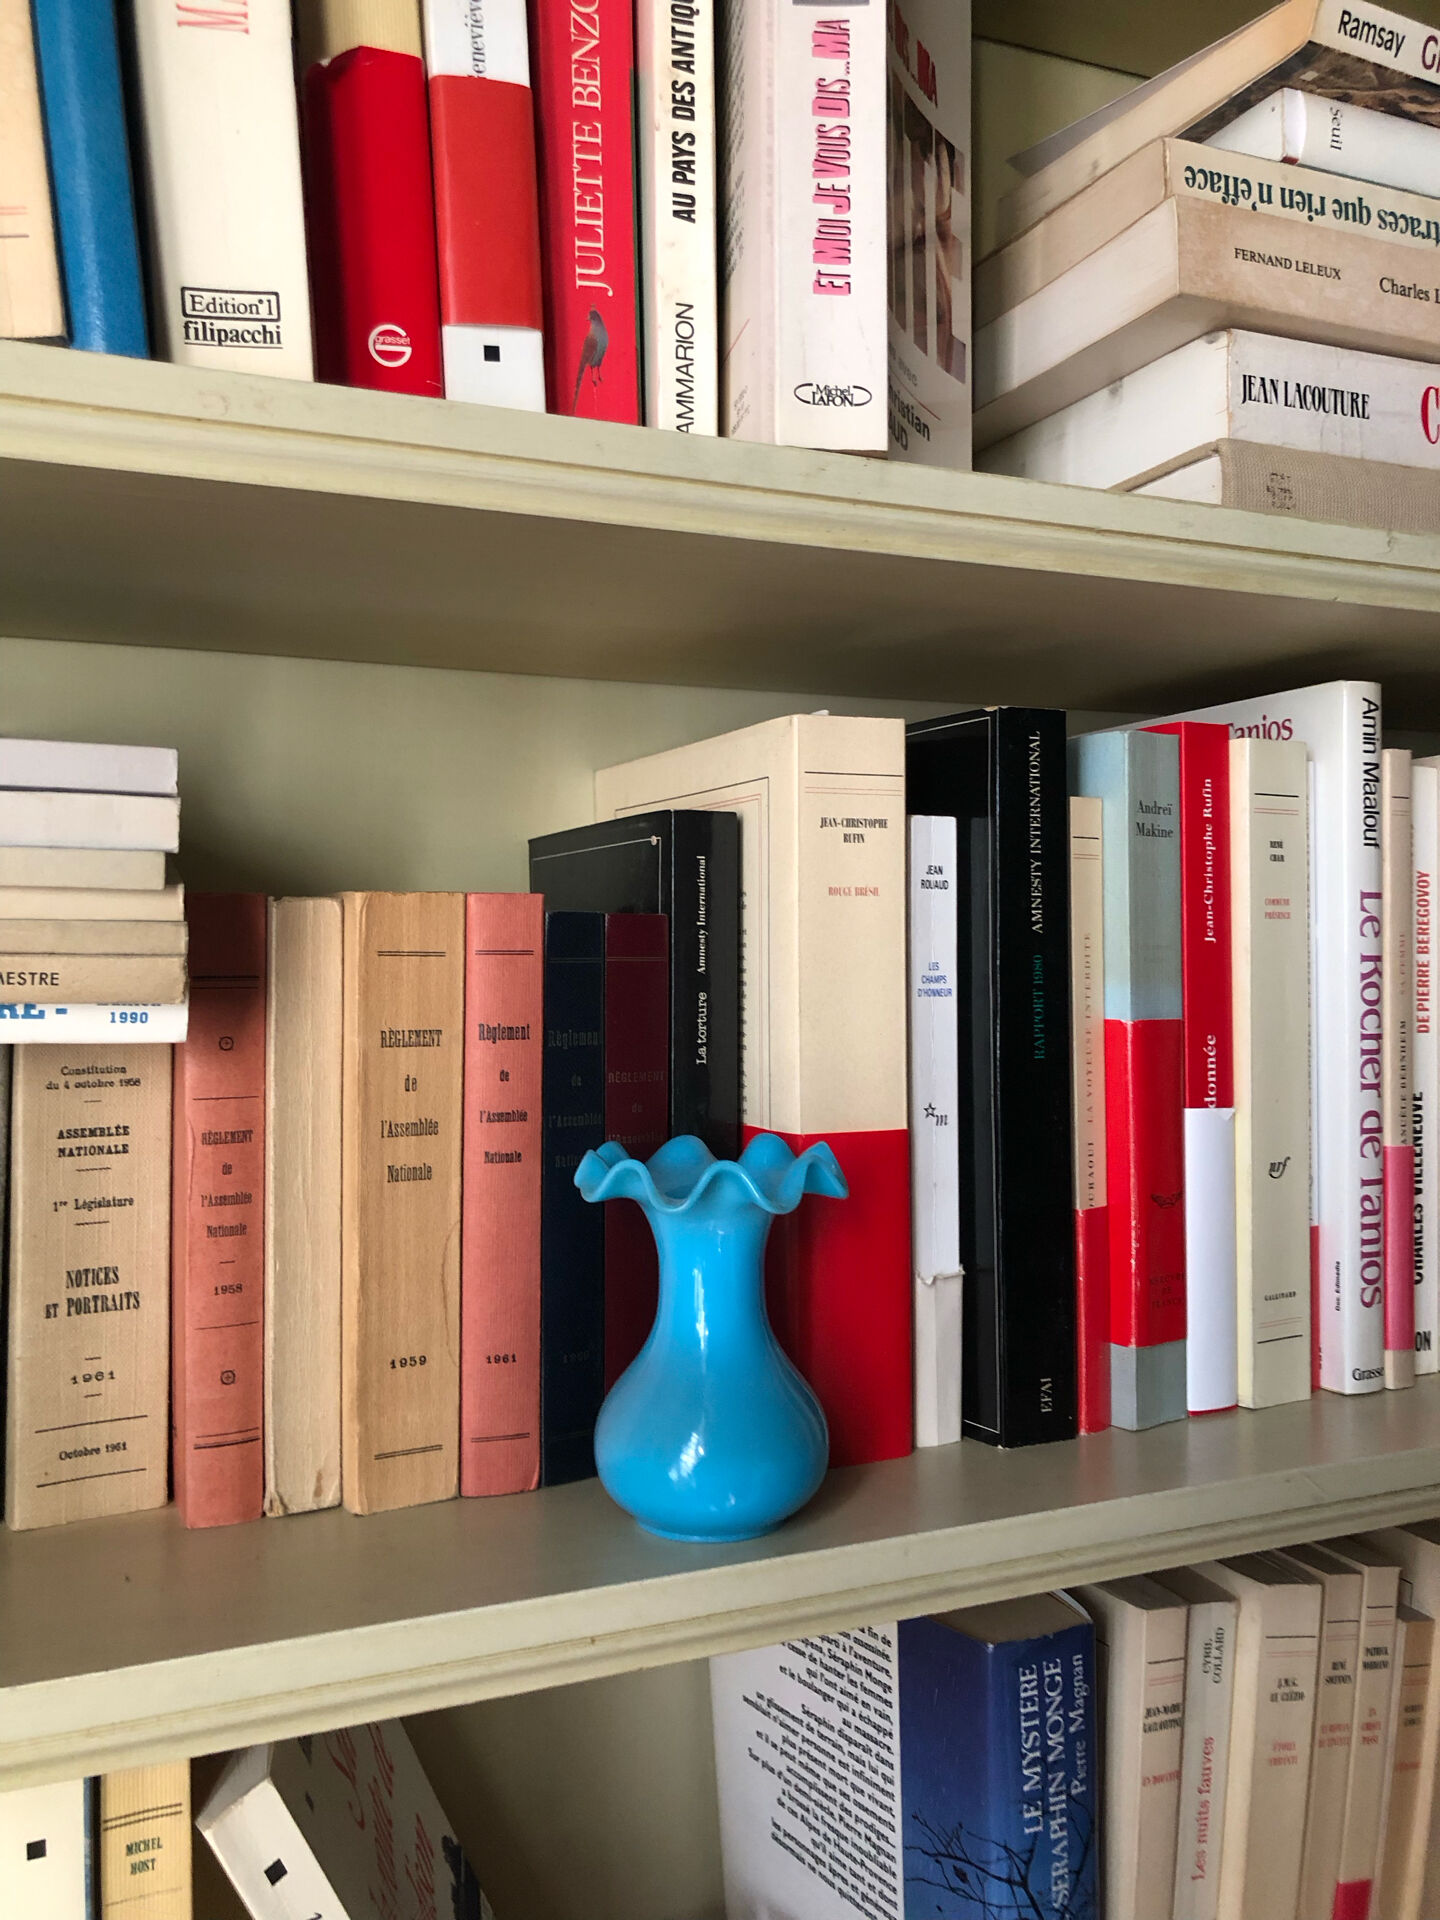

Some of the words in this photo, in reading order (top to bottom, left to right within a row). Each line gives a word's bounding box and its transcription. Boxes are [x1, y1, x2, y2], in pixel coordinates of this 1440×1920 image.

[1338, 9, 1406, 58] Ramsay
[671, 80, 696, 122] DES
[1330, 107, 1342, 151] Seuil
[672, 131, 696, 186] PAYS
[812, 124, 850, 179] VOUS
[812, 183, 850, 215] JE
[1184, 165, 1273, 211] n'efface
[573, 121, 613, 297] JULIETTE
[672, 192, 696, 224] AU
[1281, 187, 1326, 222] rien
[1332, 198, 1371, 226] que
[813, 218, 850, 265] MOI
[813, 269, 850, 295] ET
[1234, 248, 1292, 270] FERNAND
[1295, 261, 1342, 280] LELEUX
[1379, 277, 1430, 301] Charles
[184, 321, 282, 346] filipacchi
[375, 334, 411, 346] grasset
[1241, 374, 1279, 404] JEAN
[1283, 381, 1370, 419] LACOUTURE
[1362, 697, 1379, 754] Amin
[1029, 730, 1042, 852] INTERNATIONAL
[1202, 778, 1213, 818] Rufin
[1363, 761, 1379, 849] Maalouf
[820, 817, 888, 829] JEAN-CHRISTOPHE
[1136, 821, 1174, 839] Makine
[843, 833, 865, 844] RUFIN
[926, 865, 943, 876] JEAN
[1203, 824, 1216, 943] Jean-Christophe
[696, 856, 706, 926] International
[920, 879, 949, 890] ROUAUD
[1030, 859, 1043, 934] AMNESTY
[1360, 890, 1382, 938] Le
[1415, 871, 1430, 954] BEREGOVOY
[697, 928, 709, 974] Amnesty
[921, 972, 947, 984] CHAMPS
[928, 961, 940, 971] LES
[1416, 960, 1430, 1012] PIERRE
[110, 1012, 149, 1024] 1990
[697, 992, 708, 1044] torture
[1033, 988, 1046, 1060] RAPPORT
[1417, 1015, 1430, 1034] DE
[380, 1028, 442, 1048] RÈGLEMENT
[478, 1023, 530, 1043] Règlement
[696, 1046, 707, 1065] La
[61, 1064, 127, 1076] Constitution
[404, 1074, 417, 1092] de
[499, 1070, 510, 1082] de
[46, 1081, 59, 1090] du
[75, 1078, 115, 1089] octobre
[380, 1117, 439, 1138] l'Assemblée
[479, 1110, 528, 1124] l'Assemblée
[57, 1125, 130, 1139] ASSEMBLÉE
[57, 1143, 130, 1158] NATIONALE
[484, 1151, 522, 1164] Nationale
[222, 1162, 232, 1175] de
[387, 1163, 432, 1183] Nationale
[207, 1223, 247, 1238] Nationale
[66, 1266, 120, 1289] NOTICES
[214, 1284, 243, 1296] 1958
[45, 1304, 59, 1319] ET
[67, 1291, 141, 1317] PORTRAITS
[390, 1355, 427, 1369] 1959
[486, 1354, 517, 1364] 1961
[70, 1371, 116, 1385] 1961
[59, 1446, 101, 1461] Octobre
[1069, 1654, 1090, 1733] Magnan
[1043, 1658, 1065, 1762] MONGE
[1019, 1664, 1042, 1792] MYSTERE
[1198, 1736, 1215, 1795] fauves
[1024, 1801, 1043, 1834] LE
[1195, 1800, 1210, 1844] nuits
[126, 1837, 163, 1856] MICHEL
[131, 1858, 156, 1875] HOST
[1191, 1849, 1208, 1881] Les
